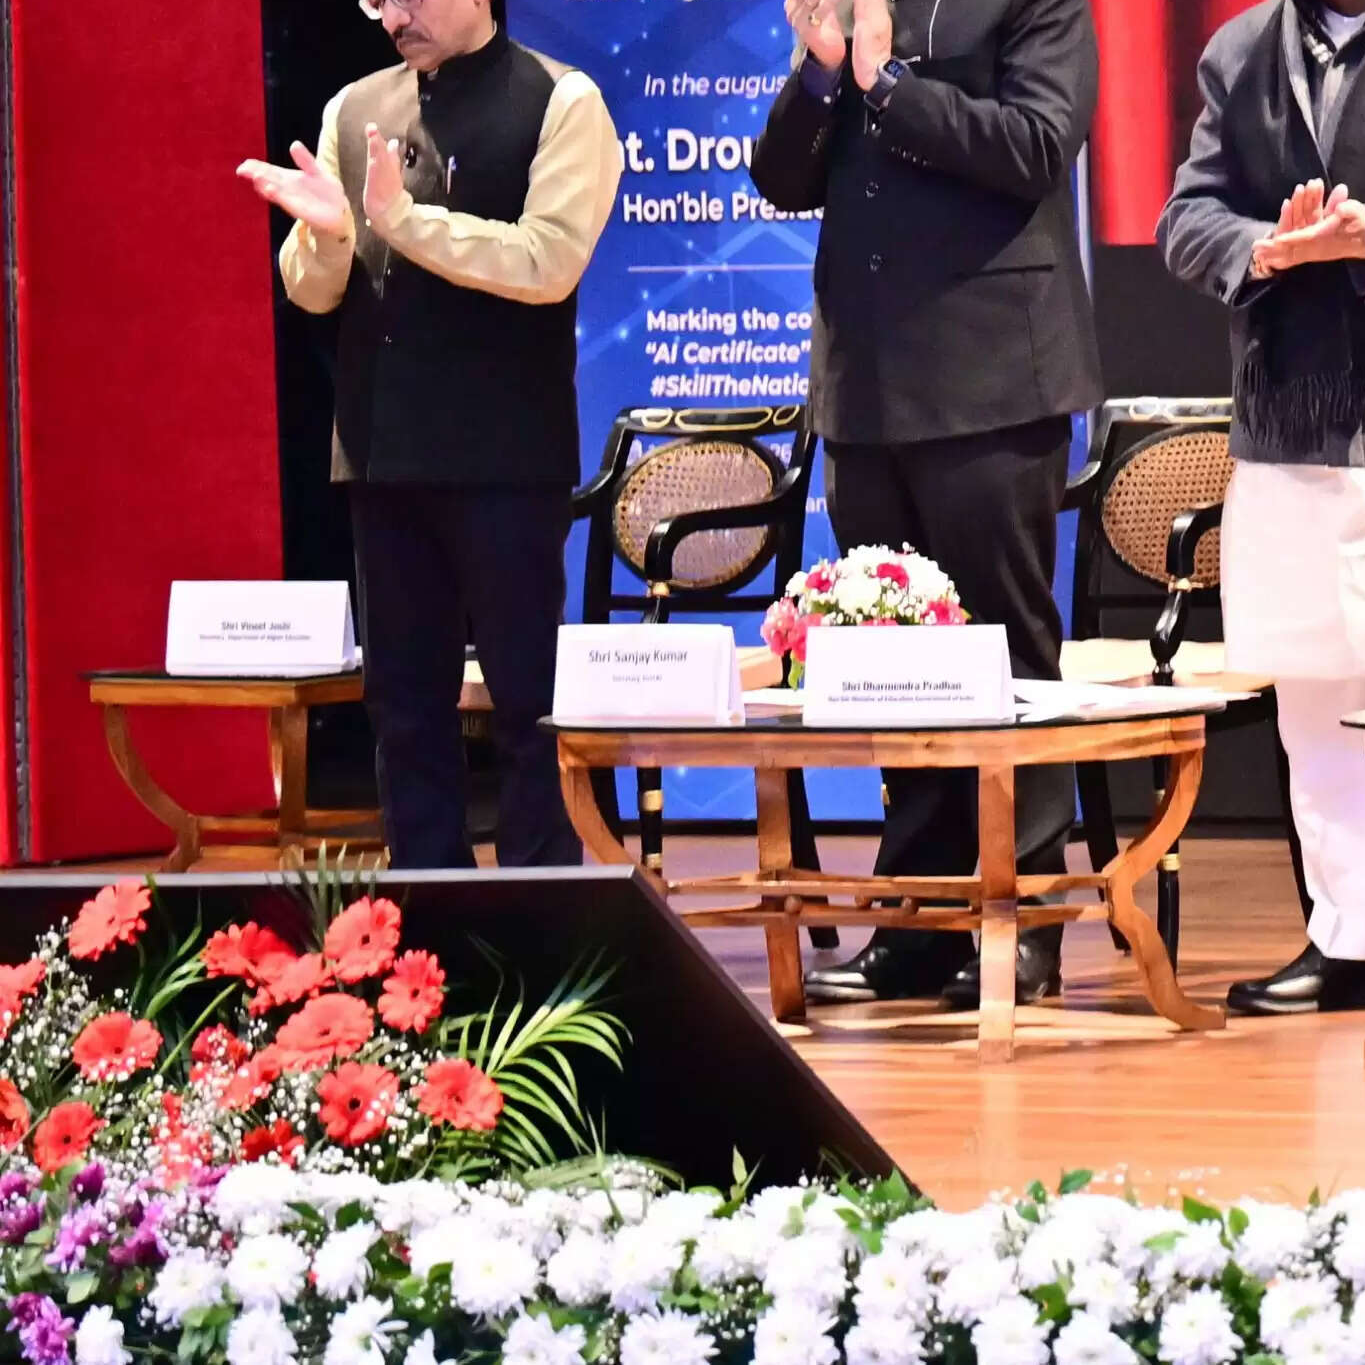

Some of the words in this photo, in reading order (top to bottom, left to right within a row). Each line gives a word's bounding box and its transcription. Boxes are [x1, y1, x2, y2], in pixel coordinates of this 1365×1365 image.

[644, 73, 665, 97] In
[672, 72, 709, 97] the
[714, 74, 788, 99] augus
[646, 307, 737, 335] Marking
[742, 307, 781, 331] the
[651, 372, 809, 398] #SkillTheNatio
[588, 649, 611, 664] Shri
[615, 649, 651, 666] Sanjay
[653, 648, 688, 663] Kumar
